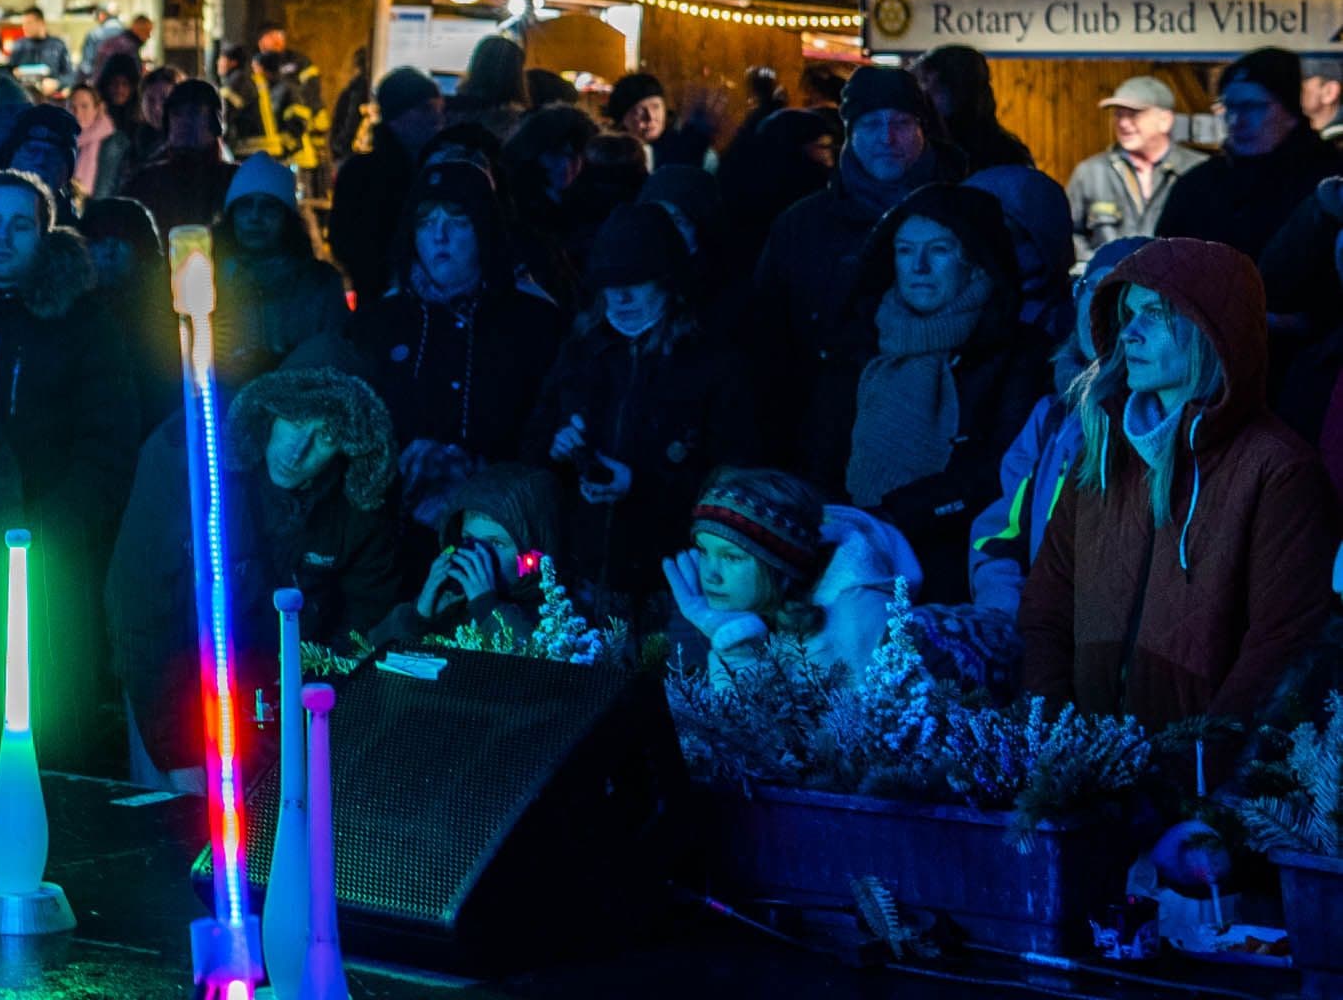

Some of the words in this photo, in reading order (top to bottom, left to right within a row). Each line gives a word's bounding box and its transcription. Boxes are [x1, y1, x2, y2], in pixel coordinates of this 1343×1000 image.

[932, 3, 1034, 43] Rotary
[1045, 0, 1121, 35] Club
[1133, 0, 1197, 34] Bad
[1209, 0, 1309, 34] Vilbel
